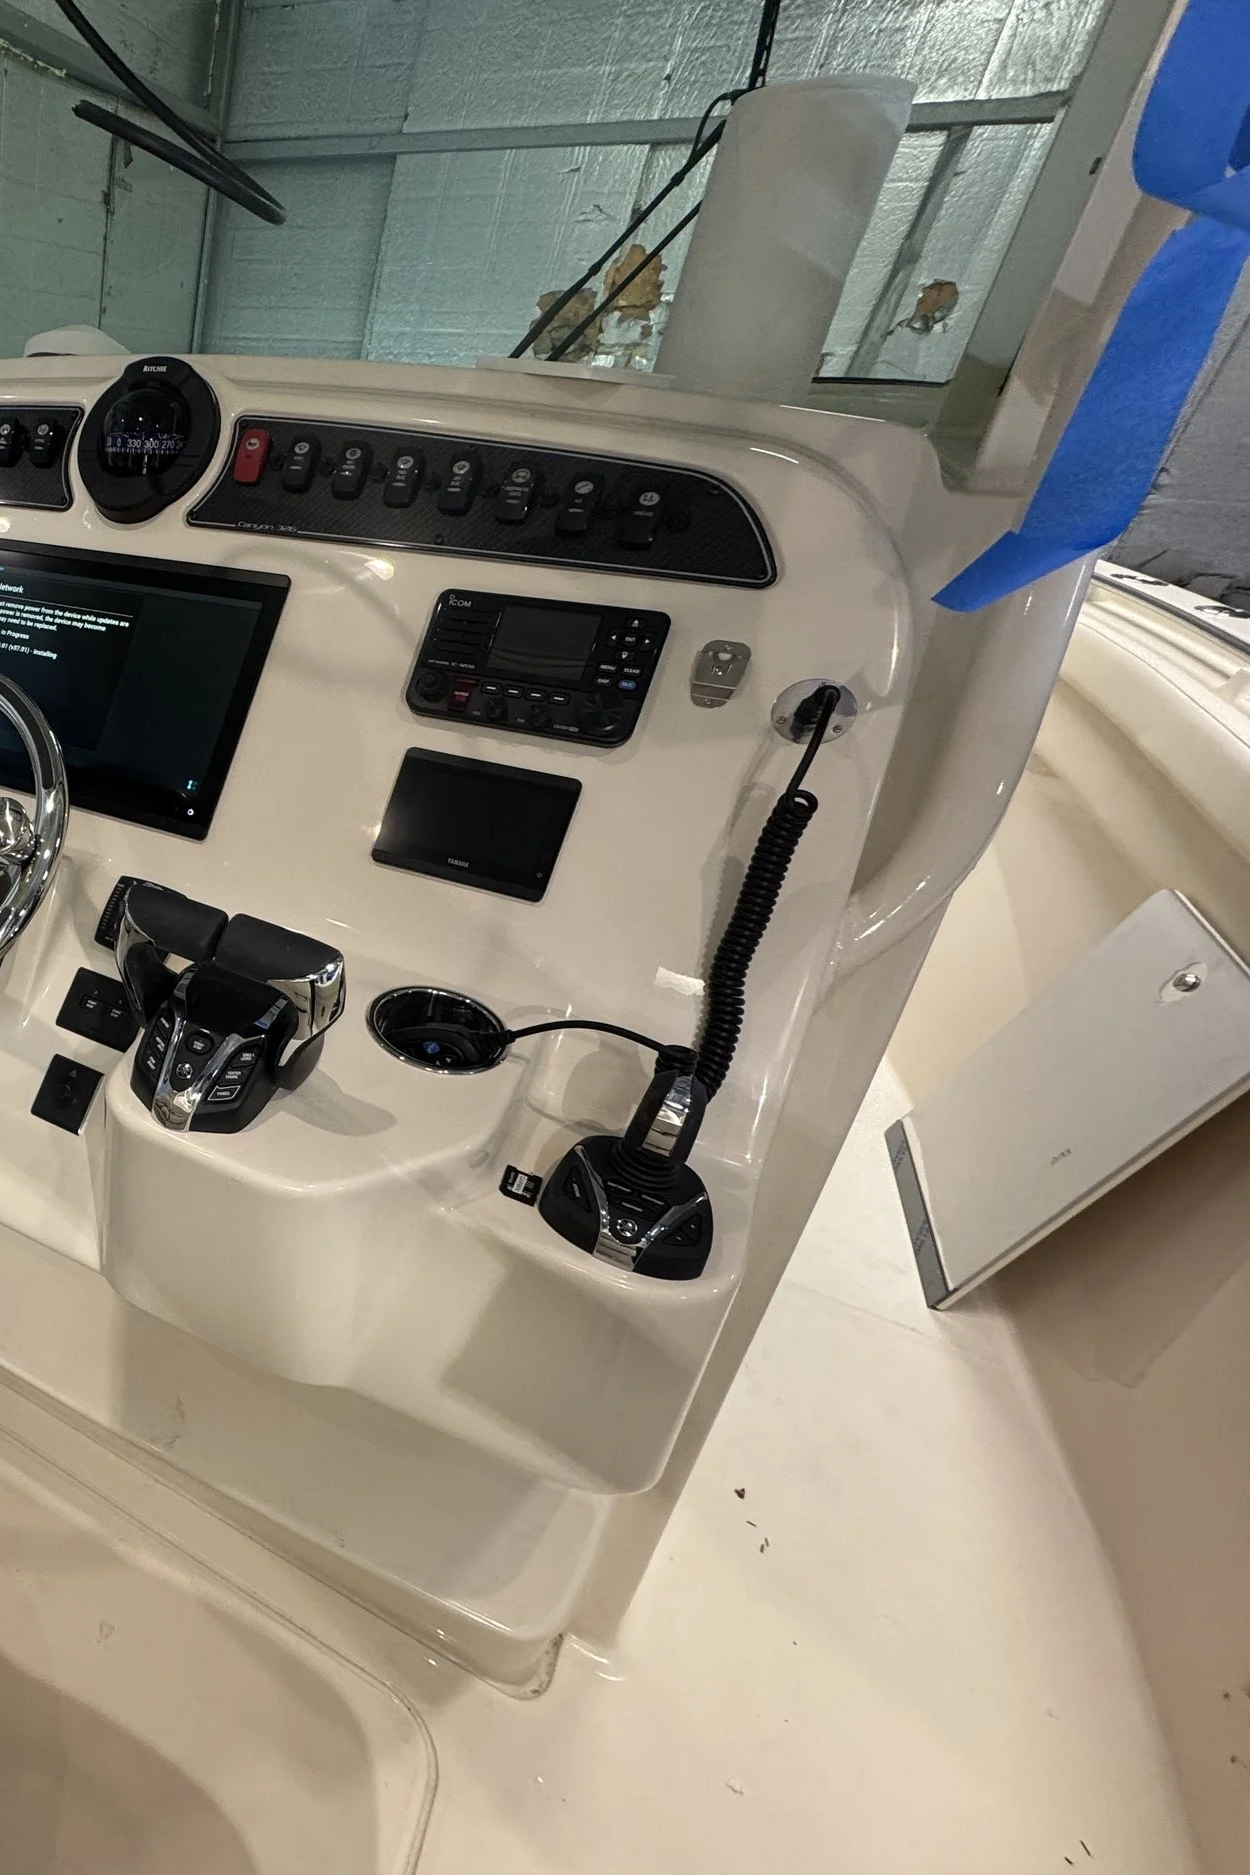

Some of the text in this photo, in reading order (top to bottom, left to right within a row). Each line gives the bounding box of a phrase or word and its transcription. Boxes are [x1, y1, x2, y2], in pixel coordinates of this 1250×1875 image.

[127, 440, 142, 448] 330
[144, 440, 159, 449] 300
[161, 440, 175, 449] 270
[41, 606, 54, 615] from
[64, 611, 81, 619] device
[96, 617, 119, 626] updates
[21, 612, 44, 621] removed,
[54, 617, 71, 625] device
[84, 622, 106, 631] become
[34, 622, 57, 631] replaced.
[7, 630, 30, 639] Progress
[33, 648, 57, 660] Installing
[448, 858, 469, 868] YAMAHA
